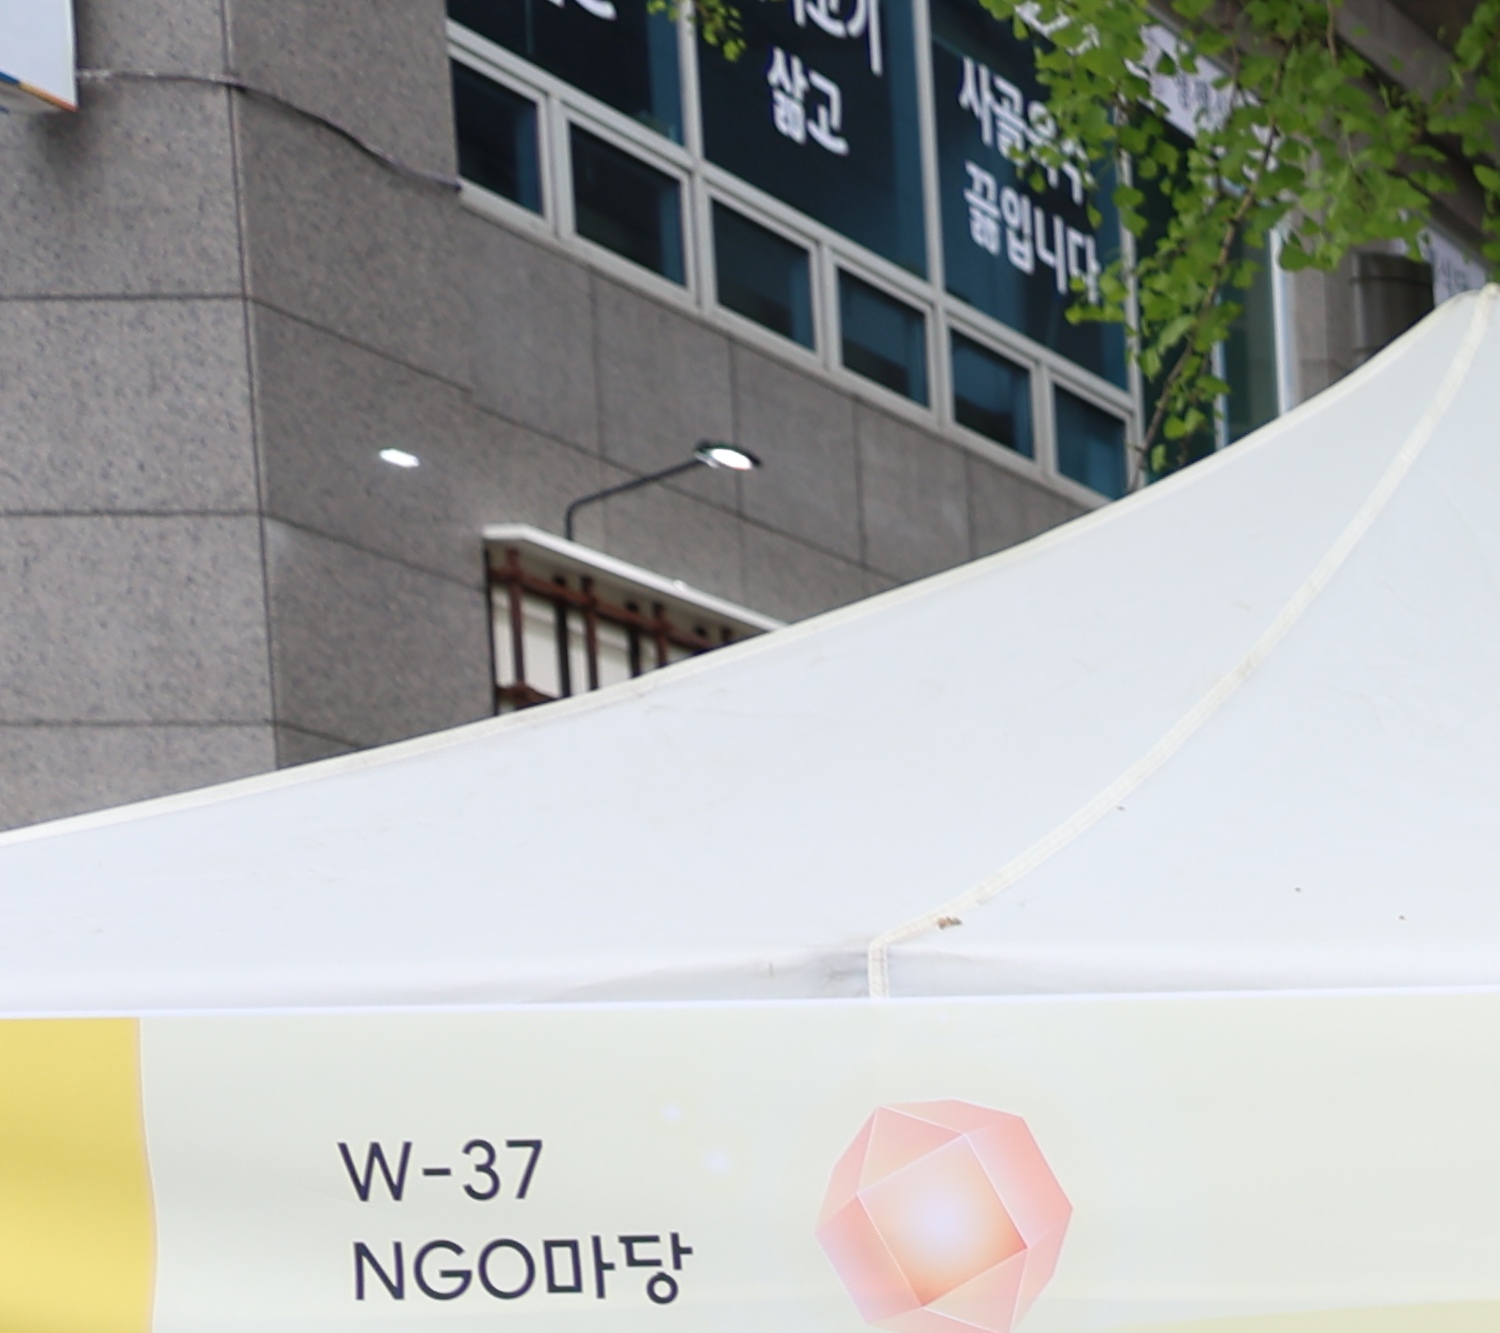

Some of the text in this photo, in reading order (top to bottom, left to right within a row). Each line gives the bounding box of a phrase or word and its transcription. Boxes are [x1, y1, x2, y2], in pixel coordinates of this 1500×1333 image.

[768, 47, 849, 155] 삶고
[965, 161, 1099, 304] 끓입니다
[338, 1140, 544, 1202] W-37
[352, 1231, 694, 1304] NGO마당
